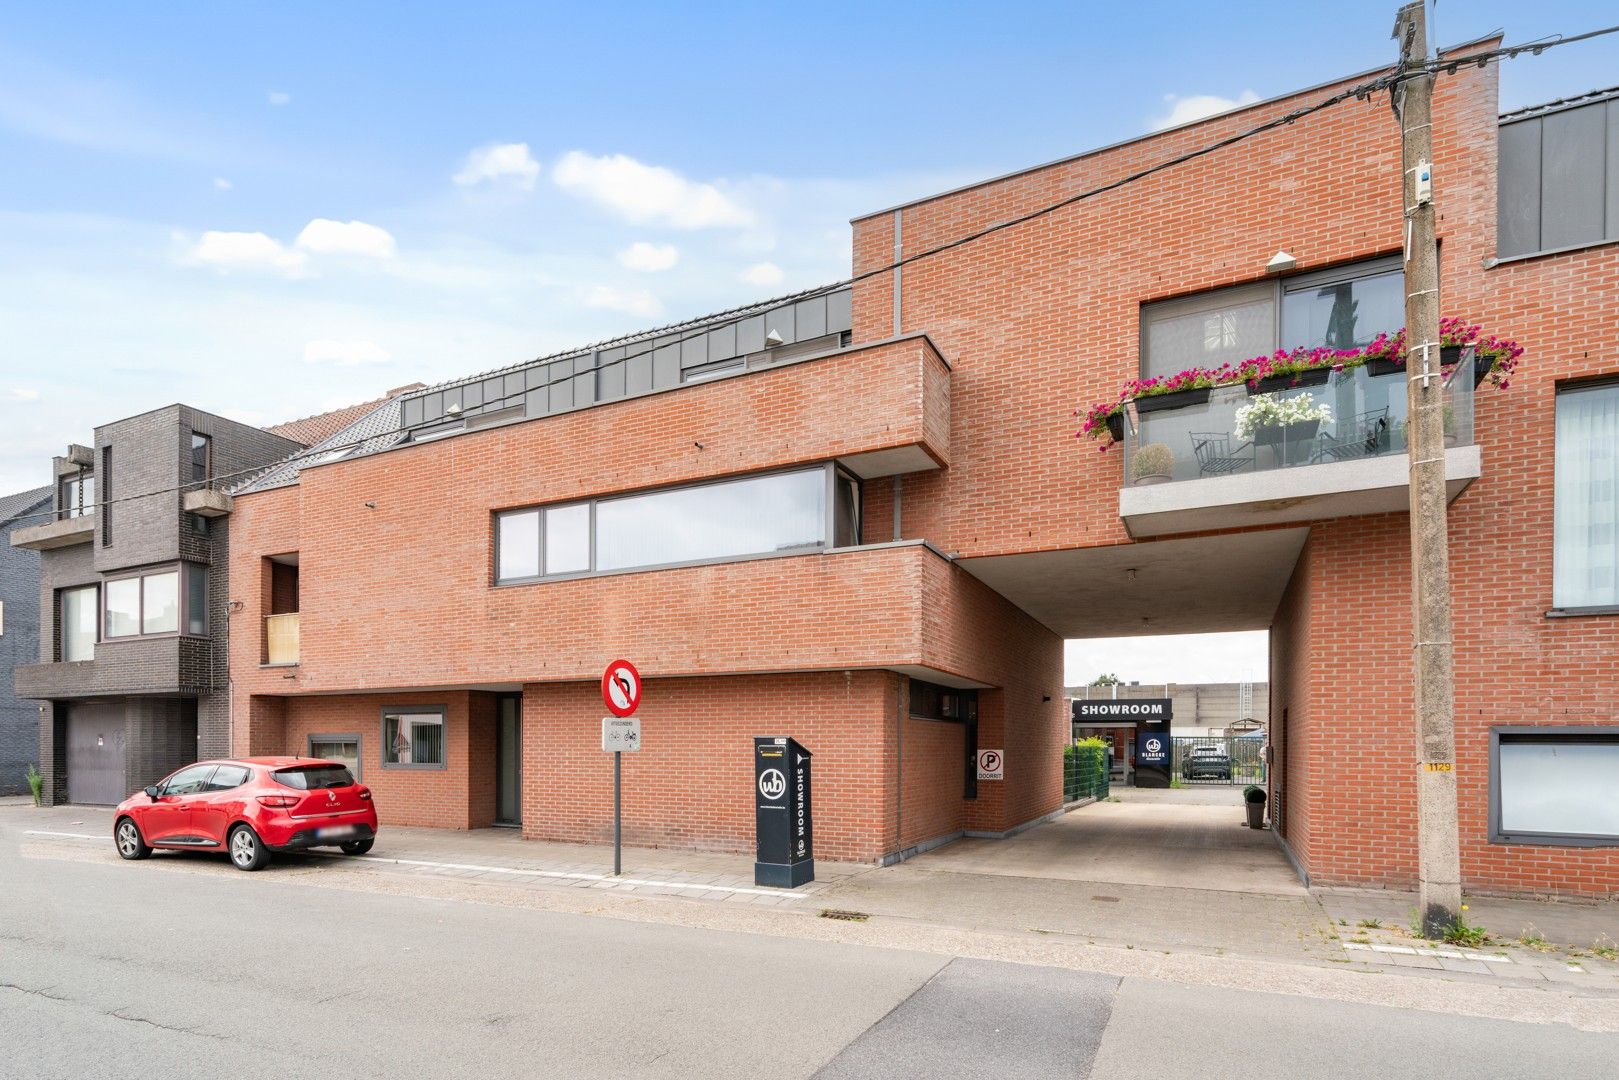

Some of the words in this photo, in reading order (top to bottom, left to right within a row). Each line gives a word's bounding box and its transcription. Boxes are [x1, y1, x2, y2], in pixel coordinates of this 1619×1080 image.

[1081, 704, 1163, 715] SHOWROOM
[1429, 762, 1451, 772] 1129
[796, 768, 804, 837] SHOWROOM
